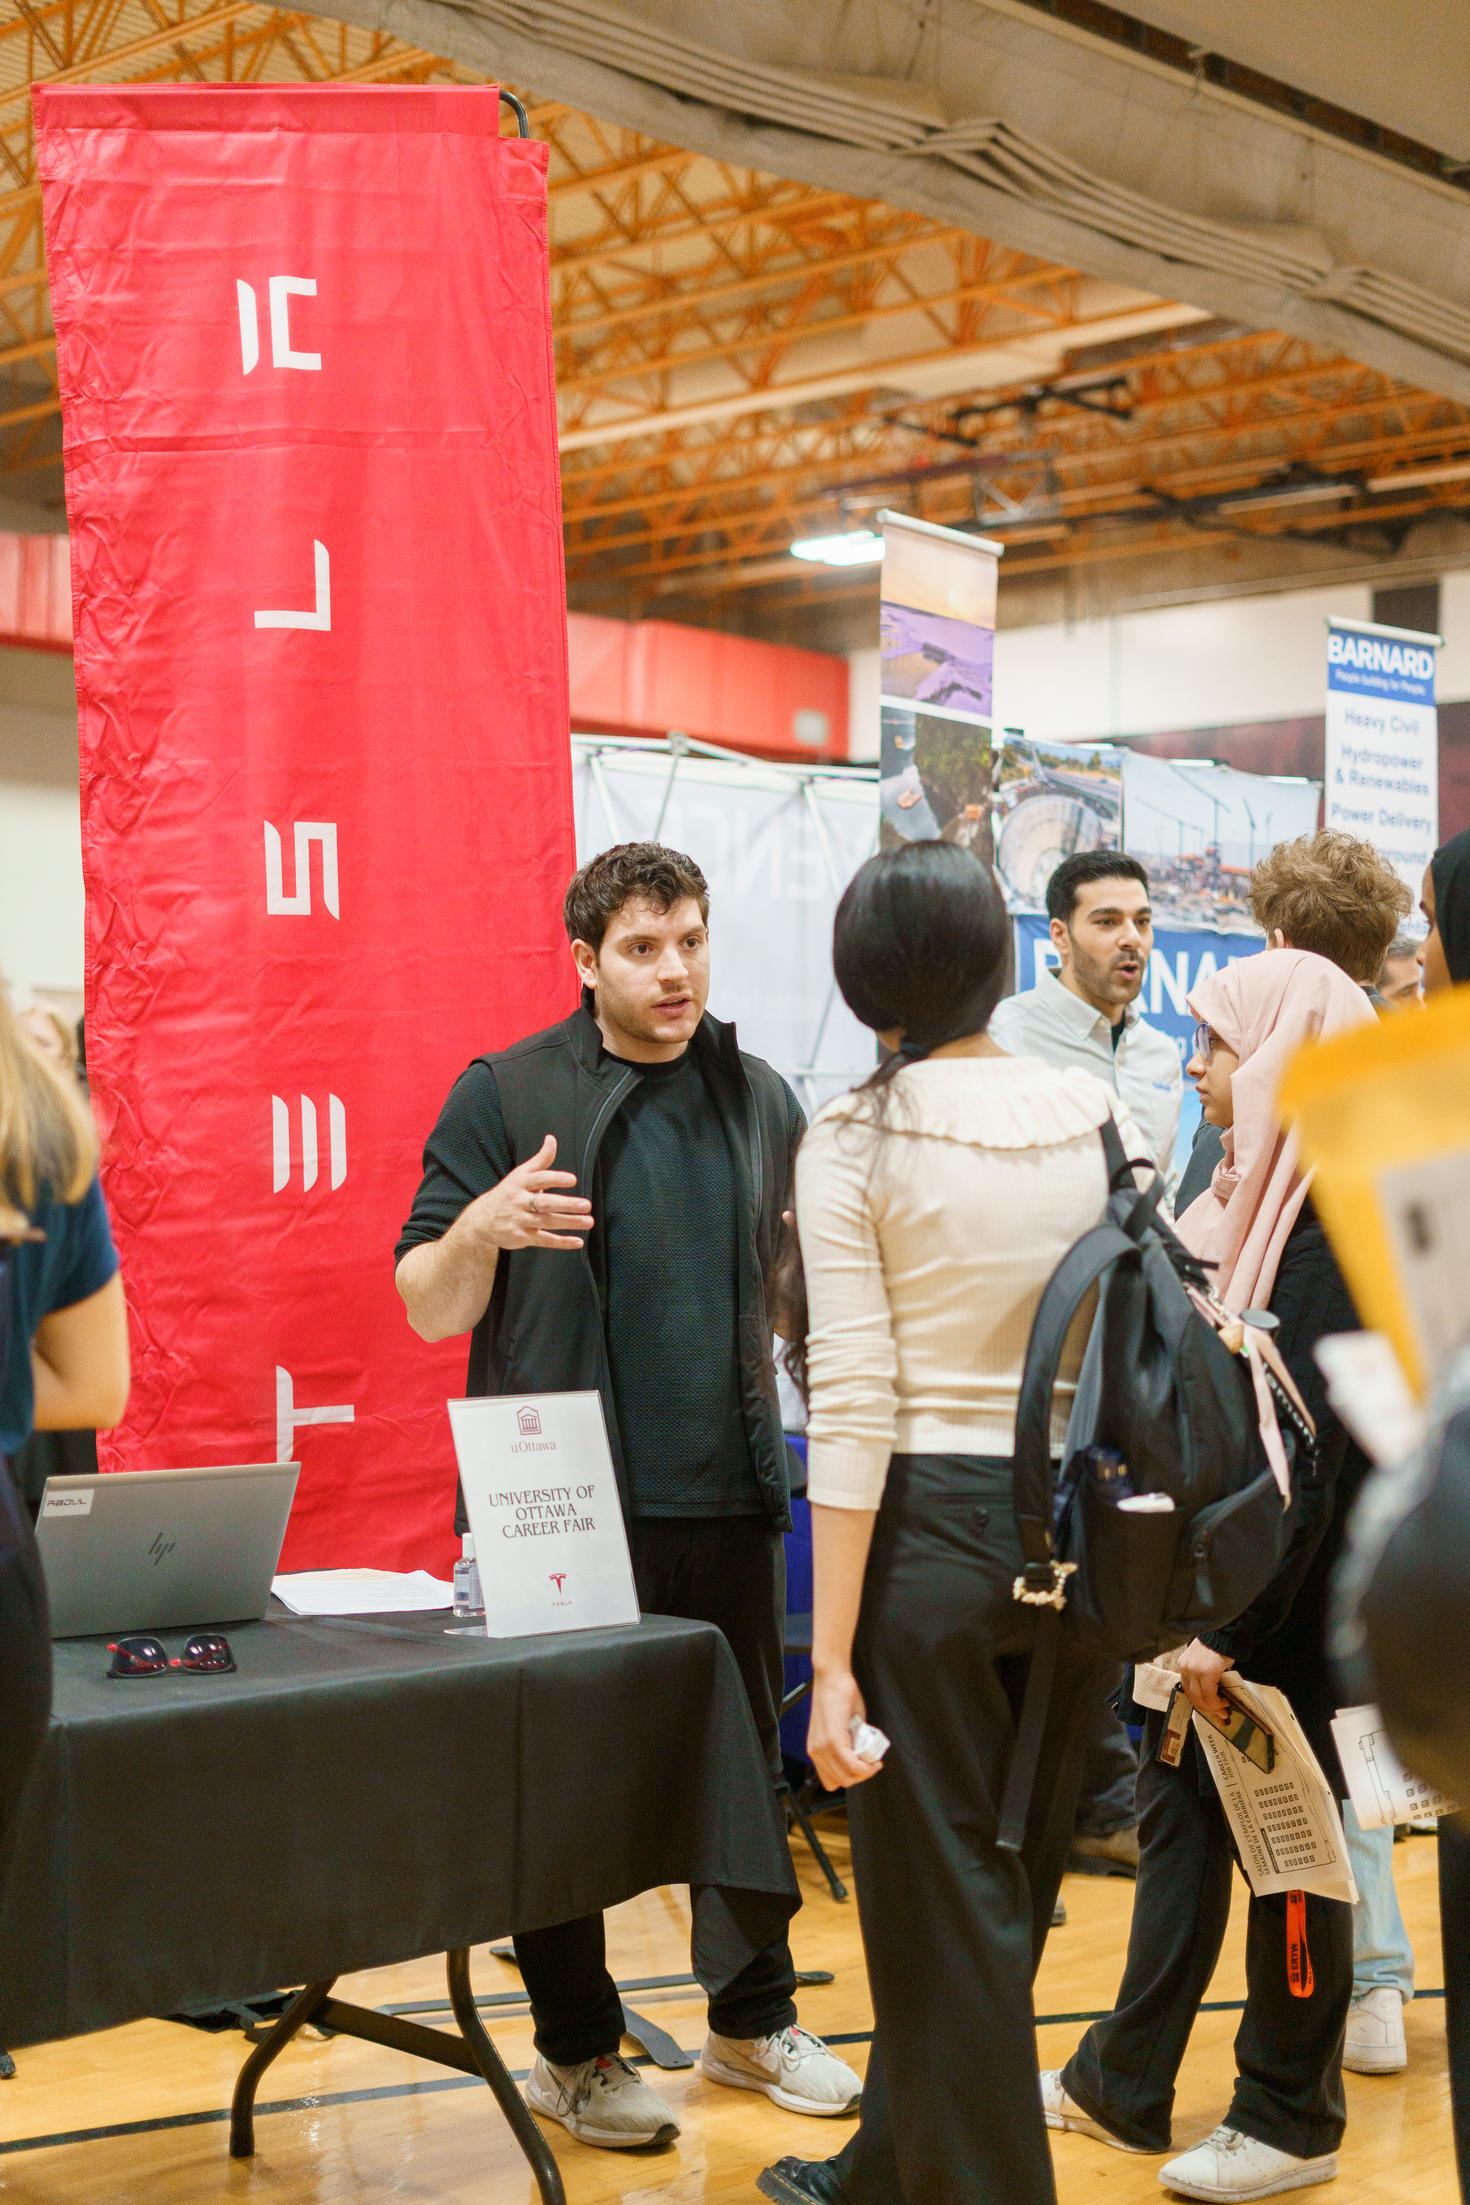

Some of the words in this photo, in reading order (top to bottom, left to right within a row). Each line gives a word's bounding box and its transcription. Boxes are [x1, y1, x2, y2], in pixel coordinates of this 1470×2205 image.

[1327, 635, 1434, 680] BARNARD
[1344, 707, 1385, 735] Heavy
[1391, 714, 1420, 736] Civil
[1341, 744, 1423, 771] Hydropower
[1335, 767, 1344, 784] &
[1350, 769, 1429, 797] Renewables
[1331, 803, 1374, 824] Power
[1379, 807, 1431, 836] Delivery
[511, 1440, 557, 1453] uOttawa
[489, 1487, 571, 1507] UNIVERSITY
[576, 1485, 595, 1499] OF
[516, 1503, 577, 1521] OTTAWA
[502, 1520, 560, 1539] CAREER
[563, 1517, 596, 1533] FAIR
[1208, 1734, 1218, 1754] WEEK
[1215, 1754, 1229, 1780] CAREER
[1252, 1854, 1264, 1877] SALON
[1256, 1846, 1270, 1876] SEMAINE
